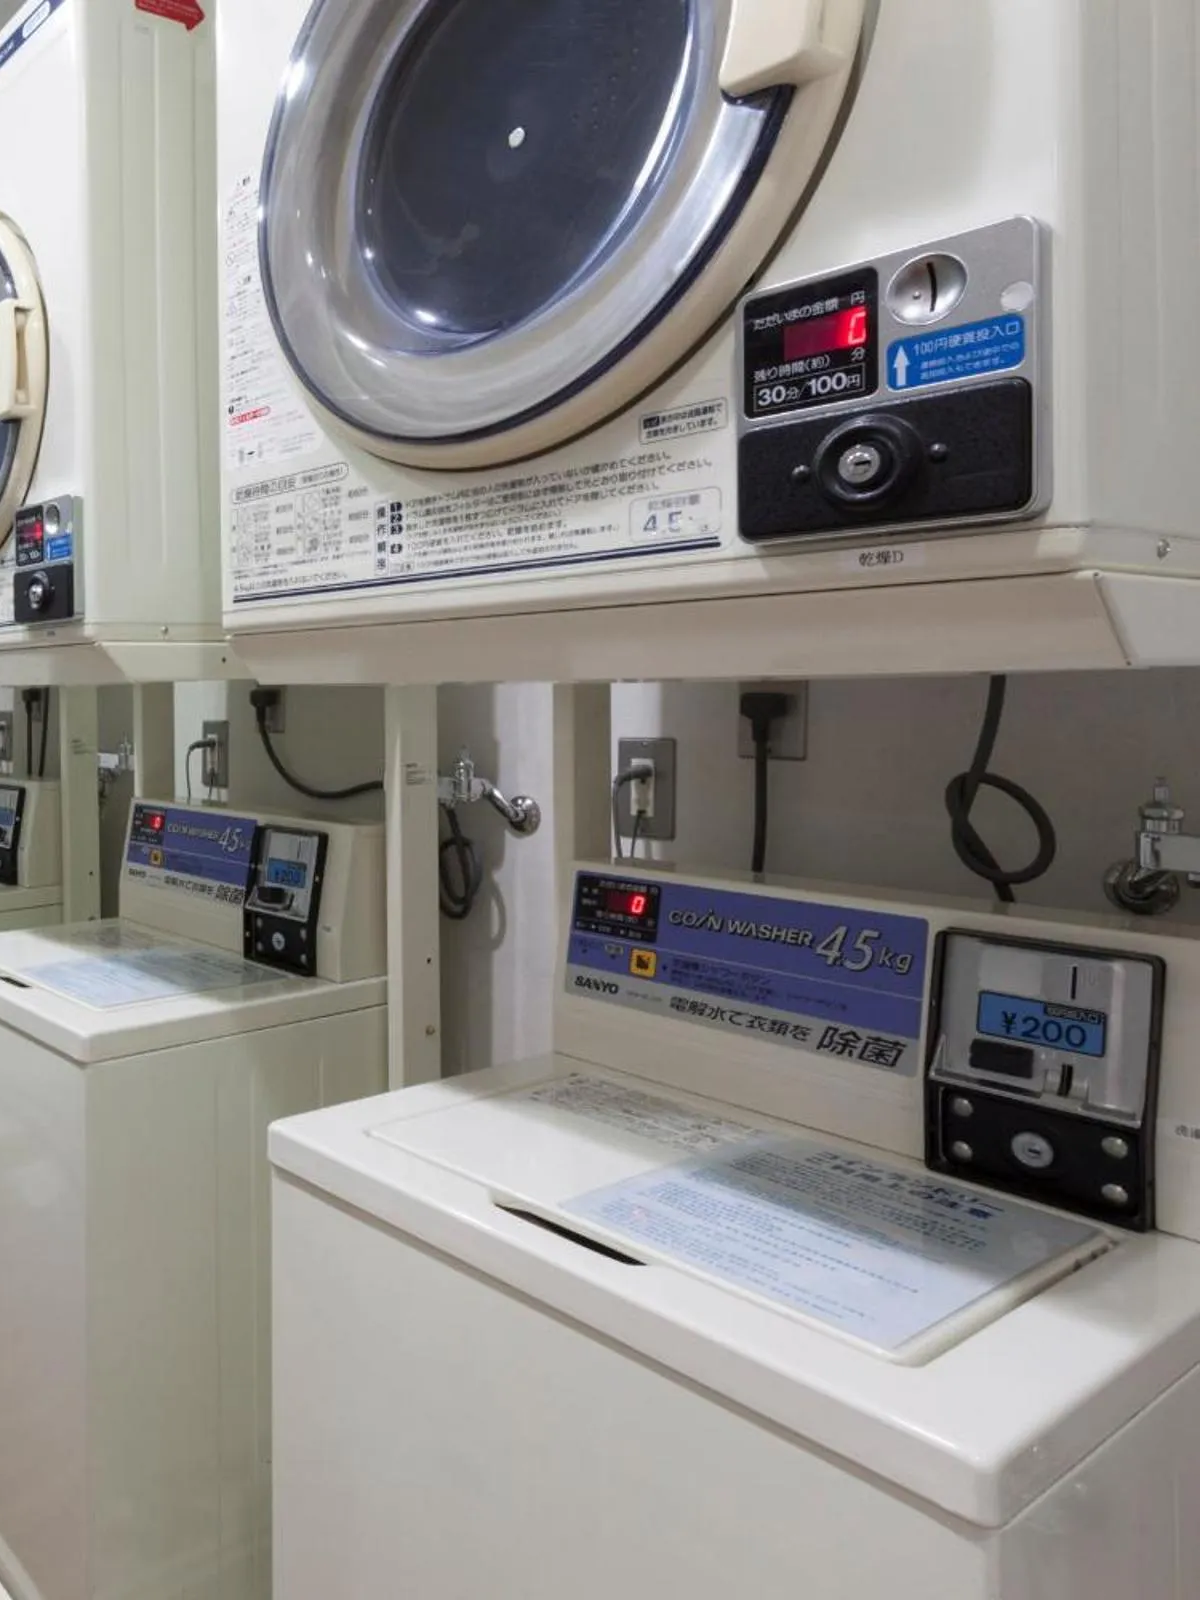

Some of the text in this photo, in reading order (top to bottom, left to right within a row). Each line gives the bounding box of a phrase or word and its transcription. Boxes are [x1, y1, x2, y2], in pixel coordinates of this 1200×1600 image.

[850, 290, 866, 305] 円
[851, 346, 866, 361] 分
[631, 895, 646, 914] 0
[668, 908, 725, 933] COIN
[727, 920, 815, 949] WASHER
[574, 974, 619, 995] SANYO
[669, 995, 908, 1069] 電解水で衣類を 除菌
[1001, 1010, 1087, 1049] ¥200
